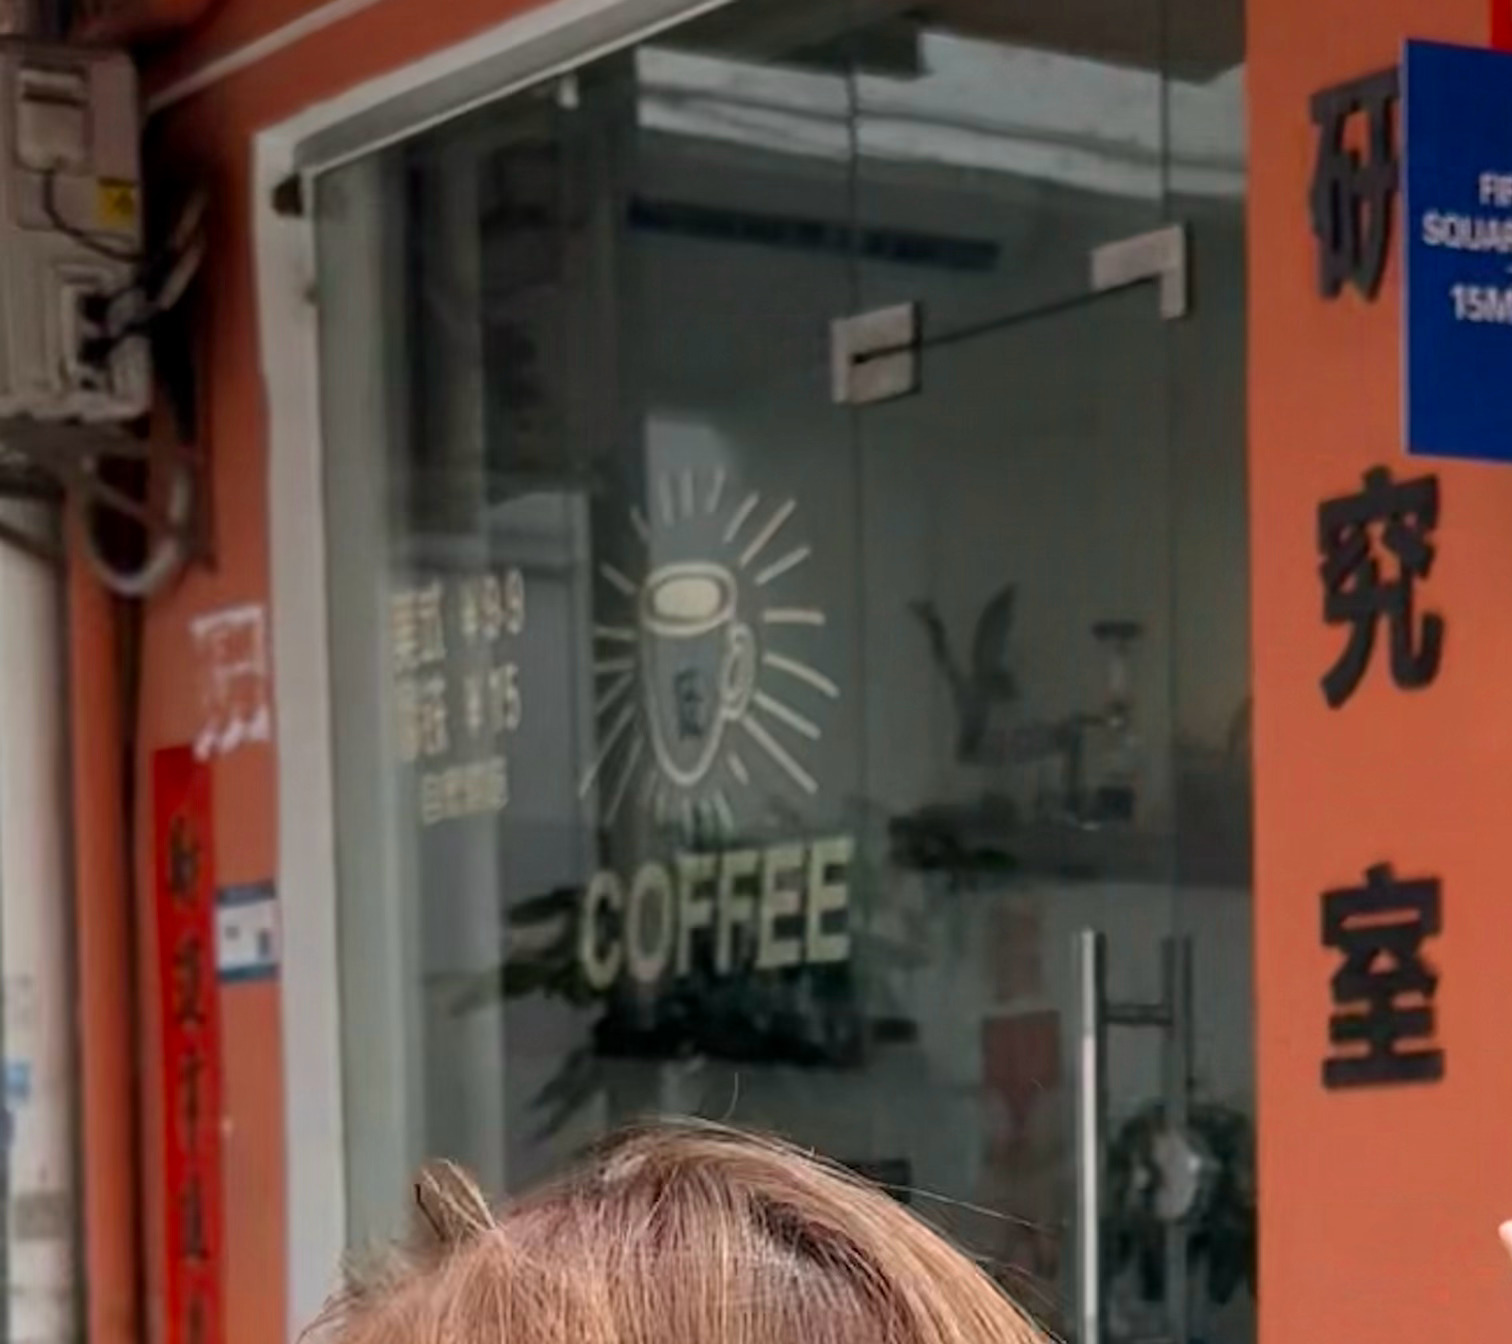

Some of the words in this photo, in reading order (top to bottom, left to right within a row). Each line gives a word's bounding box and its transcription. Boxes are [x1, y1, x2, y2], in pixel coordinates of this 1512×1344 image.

[1309, 66, 1447, 1088] 研究室
[577, 835, 855, 991] COFFEE
